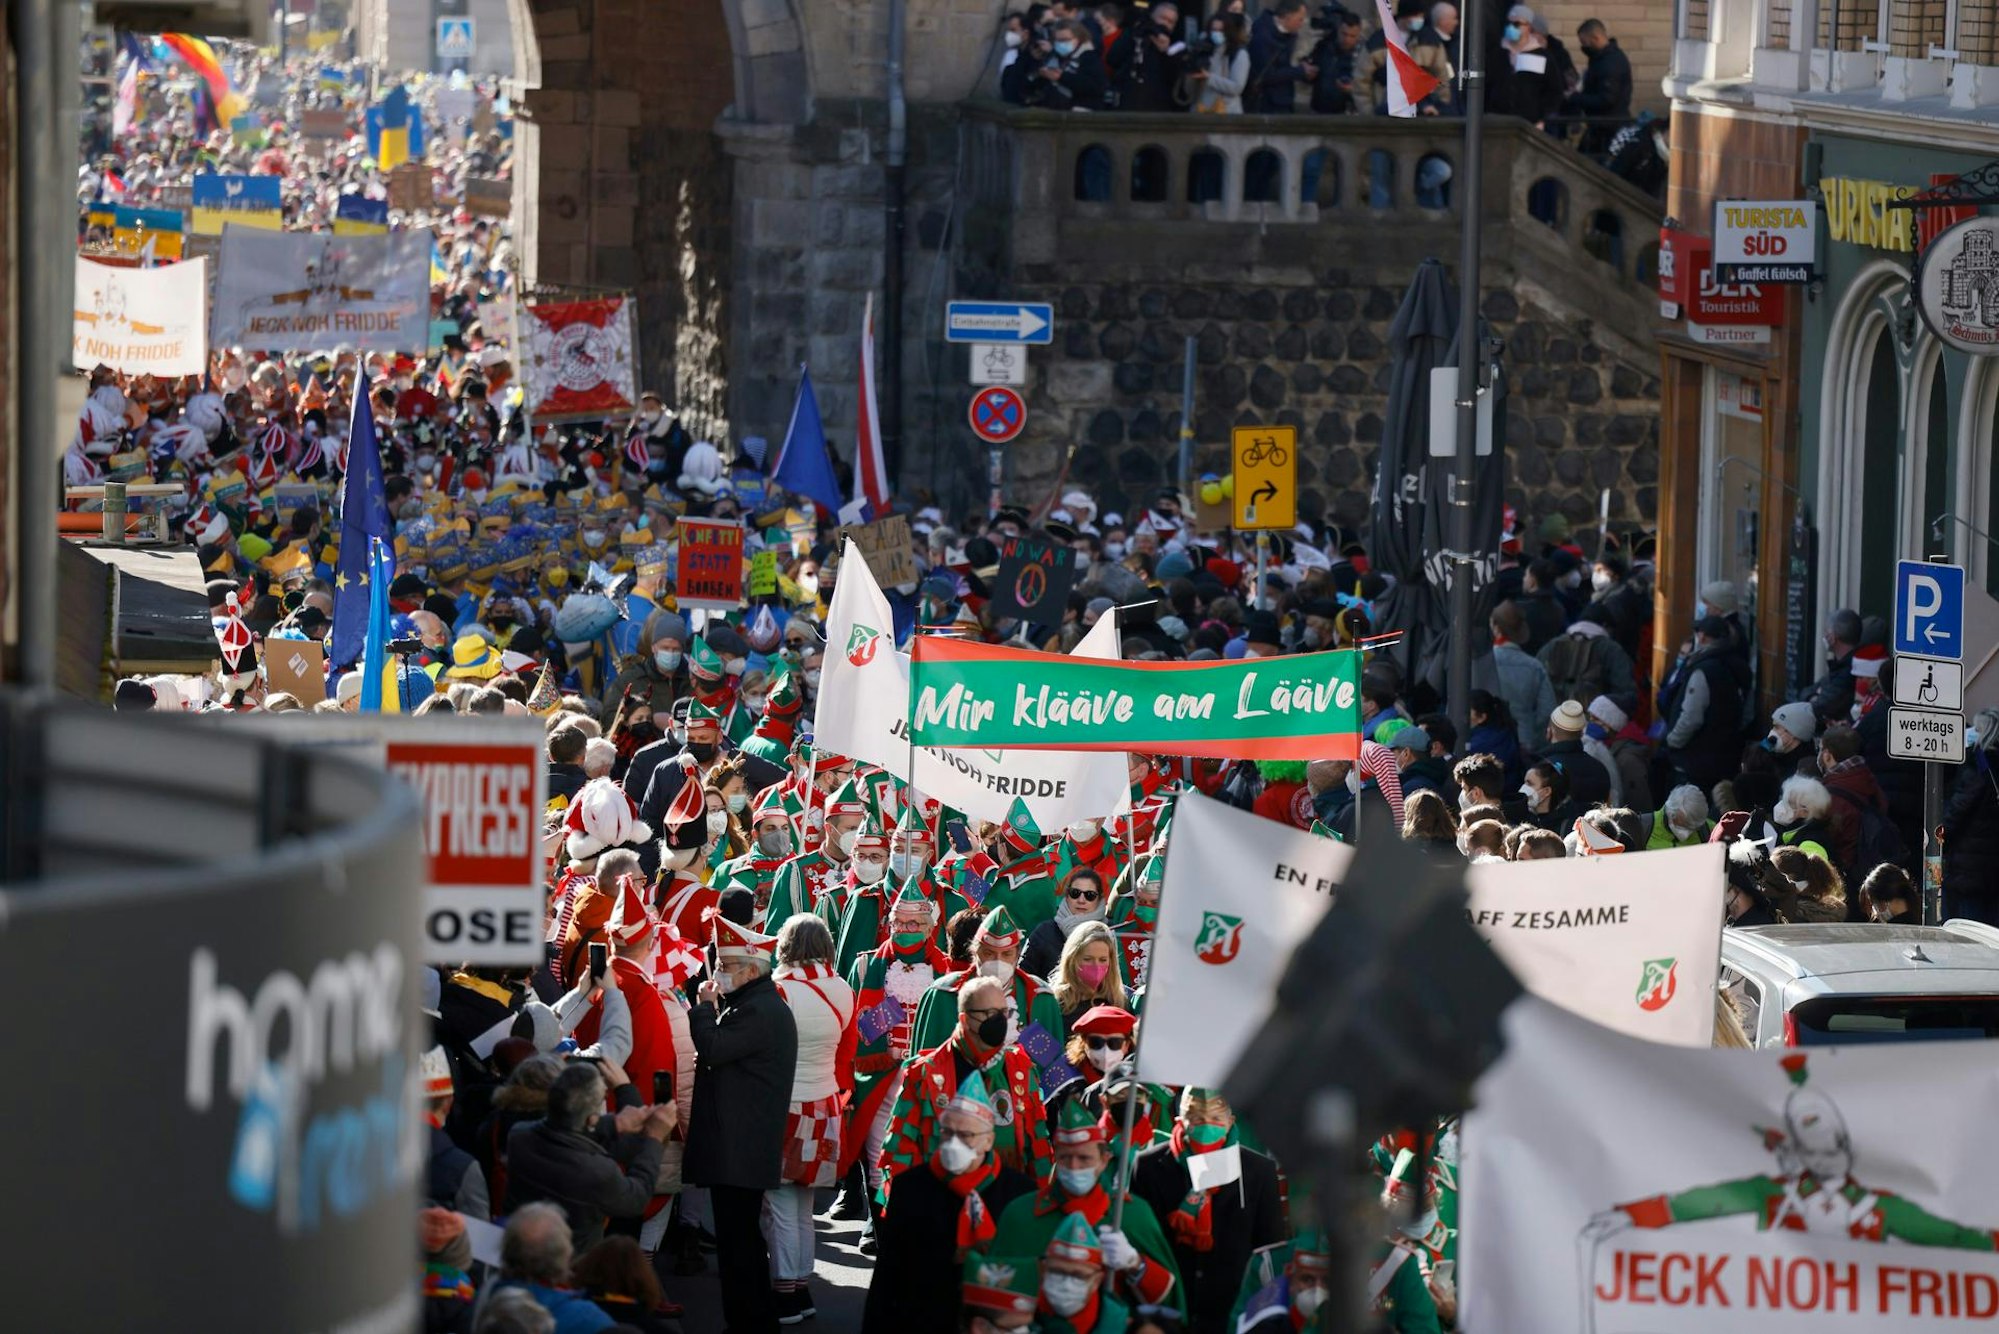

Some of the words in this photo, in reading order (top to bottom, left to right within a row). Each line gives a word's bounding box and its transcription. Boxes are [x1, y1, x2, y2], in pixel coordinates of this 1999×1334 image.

[1724, 207, 1807, 229] TURISTA
[1743, 230, 1788, 256] SÜD
[1737, 266, 1771, 281] Gaffel
[1771, 266, 1807, 281] Kölsch
[1700, 300, 1760, 313] Touristik
[334, 312, 401, 333] FRIDDE
[1705, 328, 1757, 341] Partner
[87, 341, 121, 361] NOH
[127, 341, 184, 360] FRIDDE
[1002, 538, 1025, 559] NO
[1029, 543, 1067, 567] WAR
[1906, 574, 1942, 642] P
[913, 682, 994, 732] Mir
[1012, 682, 1134, 729] klääve
[1153, 691, 1216, 722] am
[1233, 672, 1355, 720] Lääve
[1900, 718, 1954, 737] werktags
[1905, 736, 1912, 750] 8
[1924, 737, 1938, 752] 20
[1941, 739, 1948, 753] h
[940, 748, 982, 784] NOH
[987, 773, 1067, 798] FRIDDE
[387, 762, 530, 858] XPRESS
[1275, 863, 1307, 887] EN
[1511, 904, 1630, 930] ZESAMME
[426, 908, 533, 944] OSE
[1596, 1250, 1732, 1309] JECK
[1746, 1255, 1859, 1313] NOH
[1877, 1264, 1999, 1320] FRID
